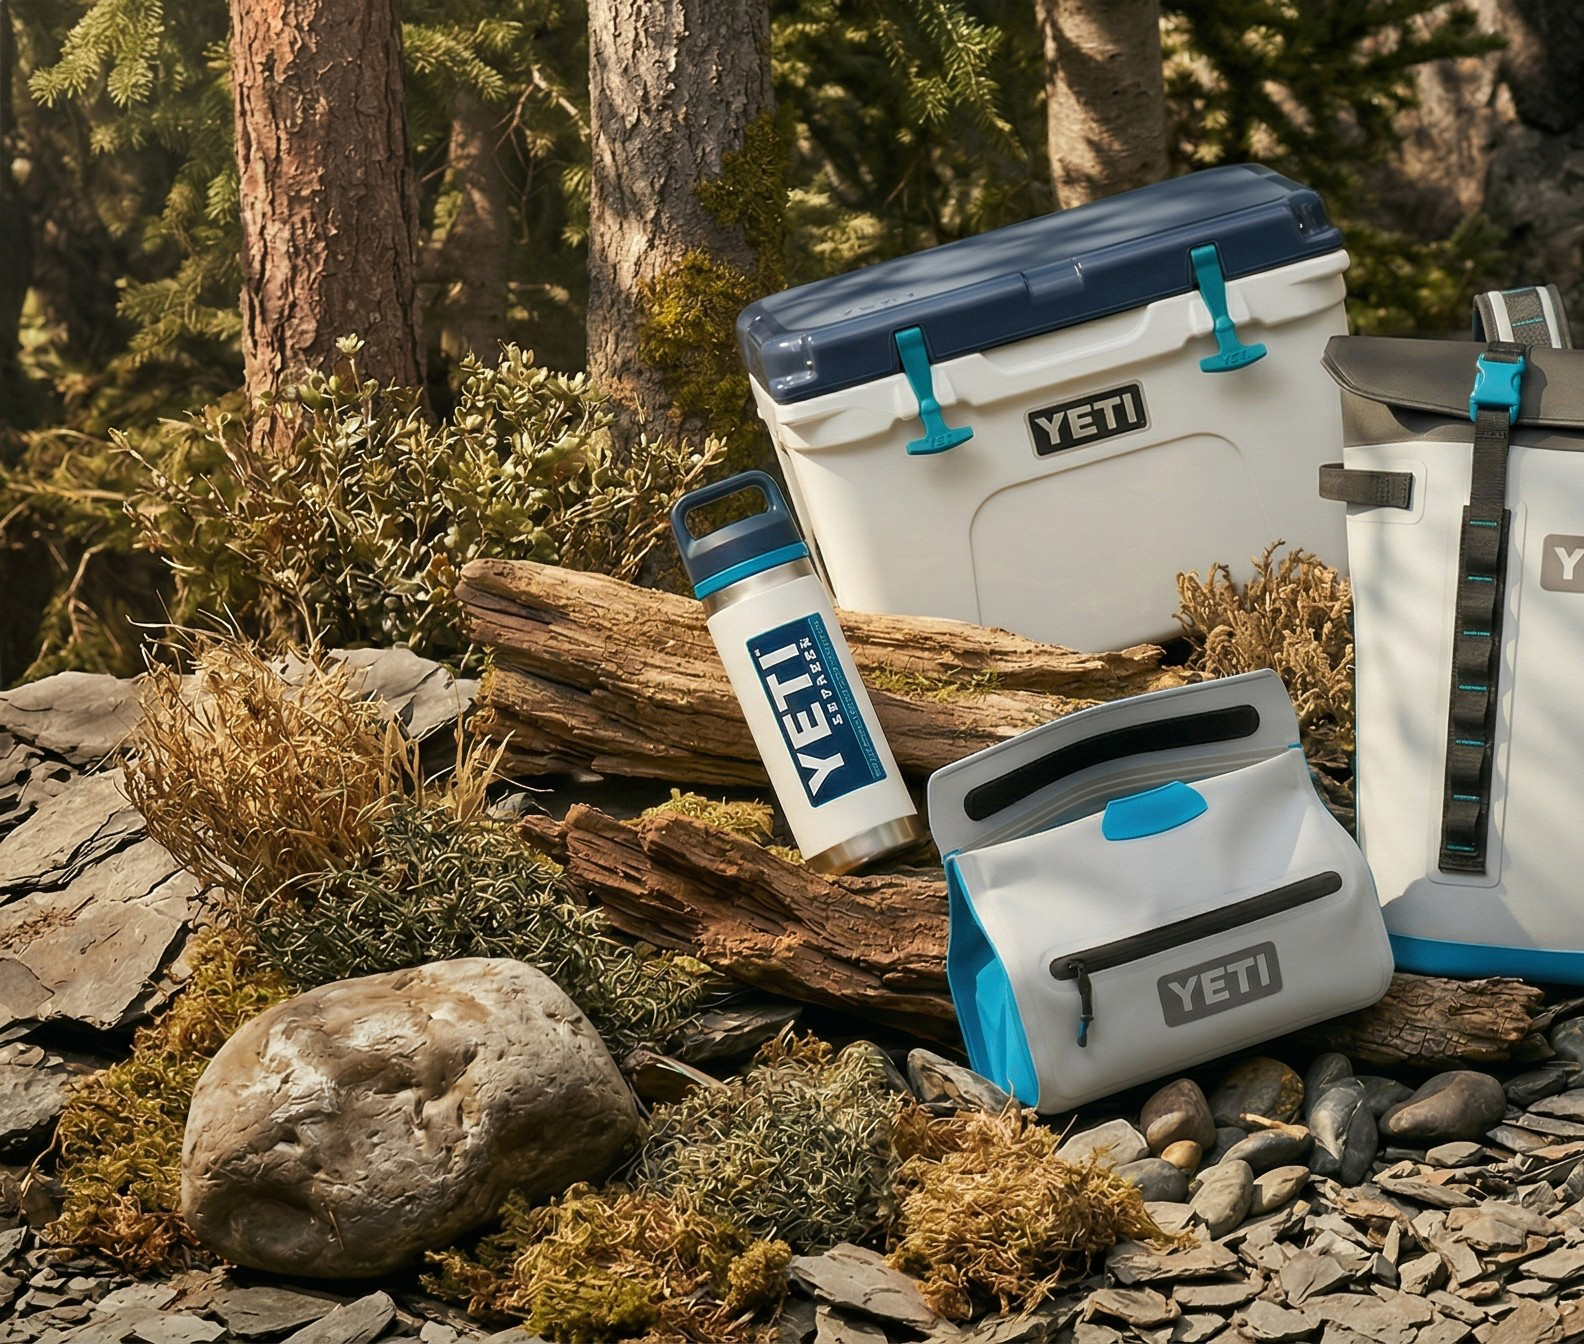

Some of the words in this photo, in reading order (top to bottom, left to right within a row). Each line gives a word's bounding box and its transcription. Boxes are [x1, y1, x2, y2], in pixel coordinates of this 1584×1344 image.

[1034, 393, 1138, 445] YETI
[758, 643, 845, 797] YETI
[1167, 953, 1270, 1012] YETI
